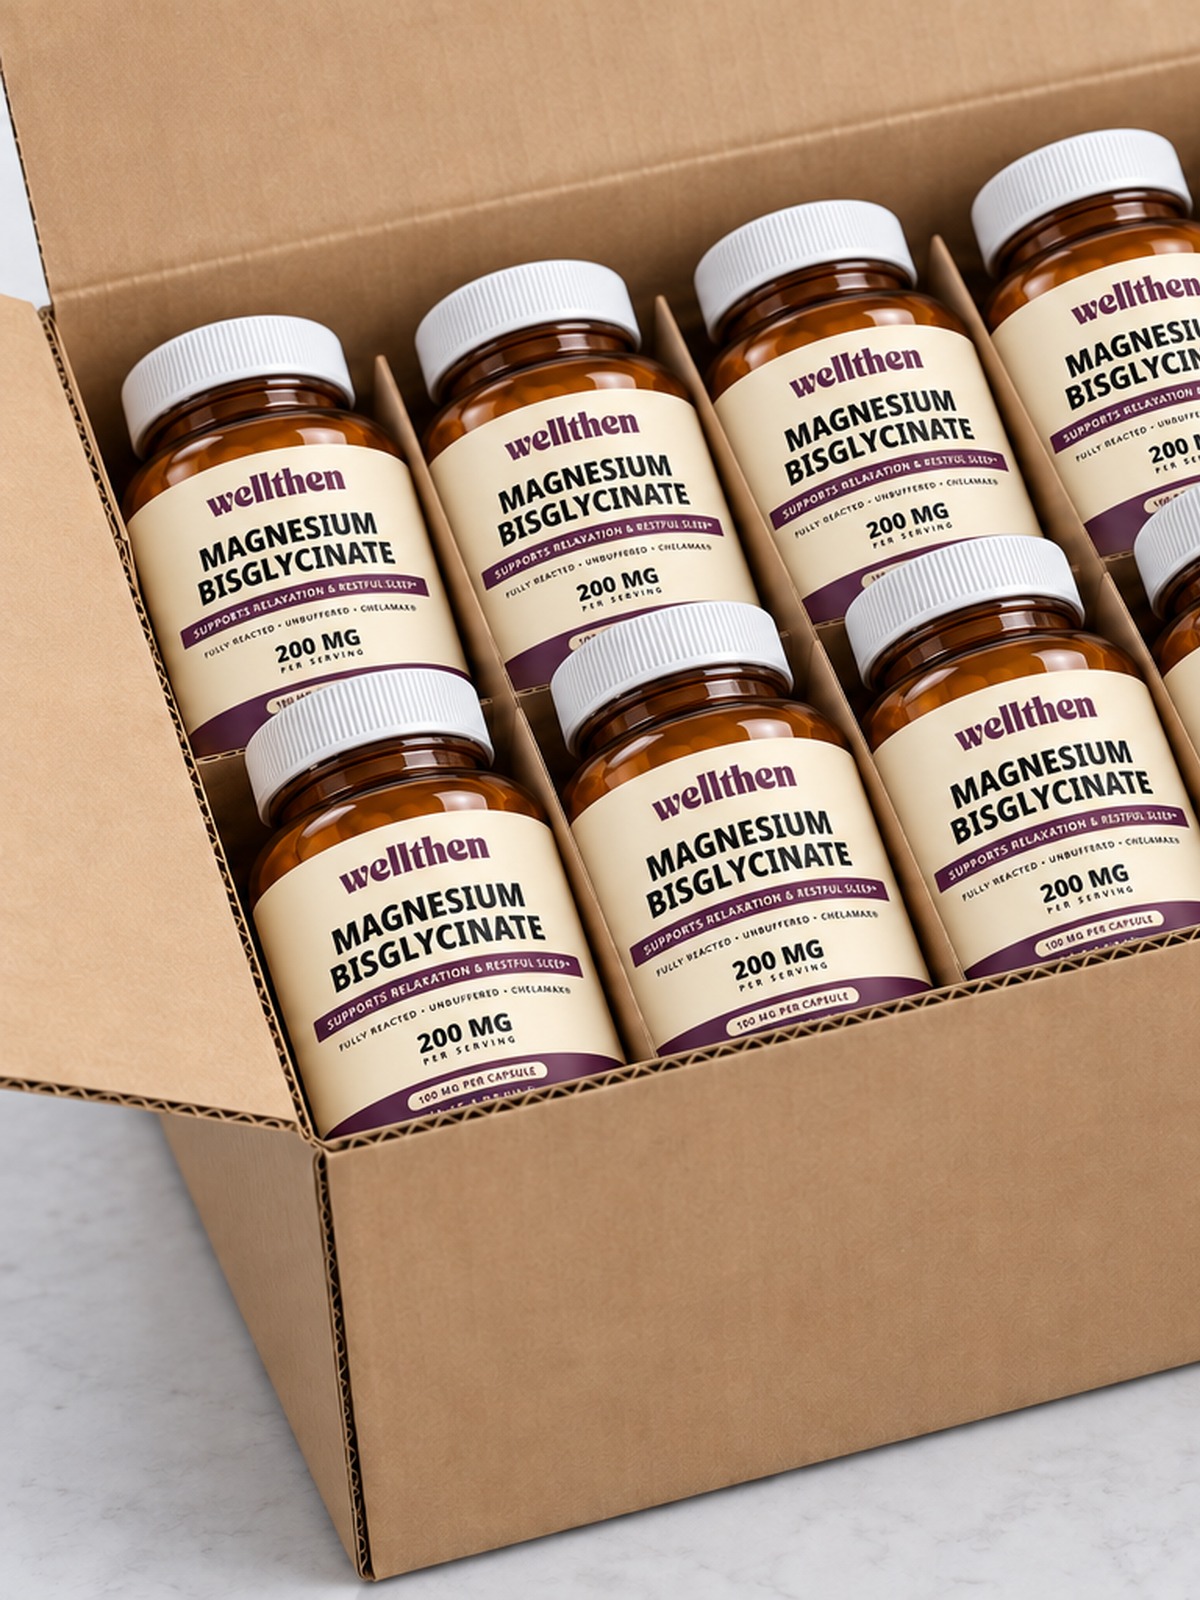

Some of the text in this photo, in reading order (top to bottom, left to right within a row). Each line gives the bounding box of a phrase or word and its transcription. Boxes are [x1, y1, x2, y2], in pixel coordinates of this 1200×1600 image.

[788, 347, 924, 398] wellthen
[504, 411, 640, 461] wellthen
[784, 389, 957, 452] MAGNESIUM
[1063, 410, 1120, 443] SUPPORTS
[784, 417, 975, 486] BISGLYCINATE
[1148, 438, 1189, 464] 200
[1155, 462, 1177, 474] PER
[206, 467, 346, 517] wellthen
[497, 454, 672, 515] MAGNESIUM
[782, 485, 838, 519] SUPPORTS
[497, 482, 690, 547] BISGLYCINATE
[865, 502, 949, 539] 200 MG
[198, 512, 377, 572] MAGNESIUM
[872, 536, 894, 549] PER
[197, 541, 396, 606] BISGLYCINATE
[494, 547, 550, 579] SUPPORTS
[576, 567, 659, 602] 200 MG
[193, 606, 249, 639] SUPPORTS
[581, 599, 604, 612] PER
[275, 628, 361, 663] 200 MG
[280, 661, 302, 673] PER
[954, 695, 1098, 751] wellthen
[651, 764, 797, 821] wellthen
[949, 740, 1133, 810] MAGNESIUM
[950, 770, 1153, 845] BISGLYCINATE
[338, 835, 490, 894] wellthen
[646, 810, 833, 882] MAGNESIUM
[950, 845, 1008, 881] SUPPORTS
[646, 841, 852, 919] BISGLYCINATE
[1039, 864, 1129, 903] 200 MG
[331, 882, 525, 955] MAGNESIUM
[1046, 900, 1071, 914] PER
[330, 915, 546, 993] BISGLYCINATE
[644, 919, 703, 956] SUPPORTS
[732, 939, 824, 981] 200 MG
[738, 978, 763, 992] PER
[327, 992, 387, 1030] SUPPORTS
[416, 1013, 512, 1054] 200 MG
[423, 1051, 447, 1065] PER
